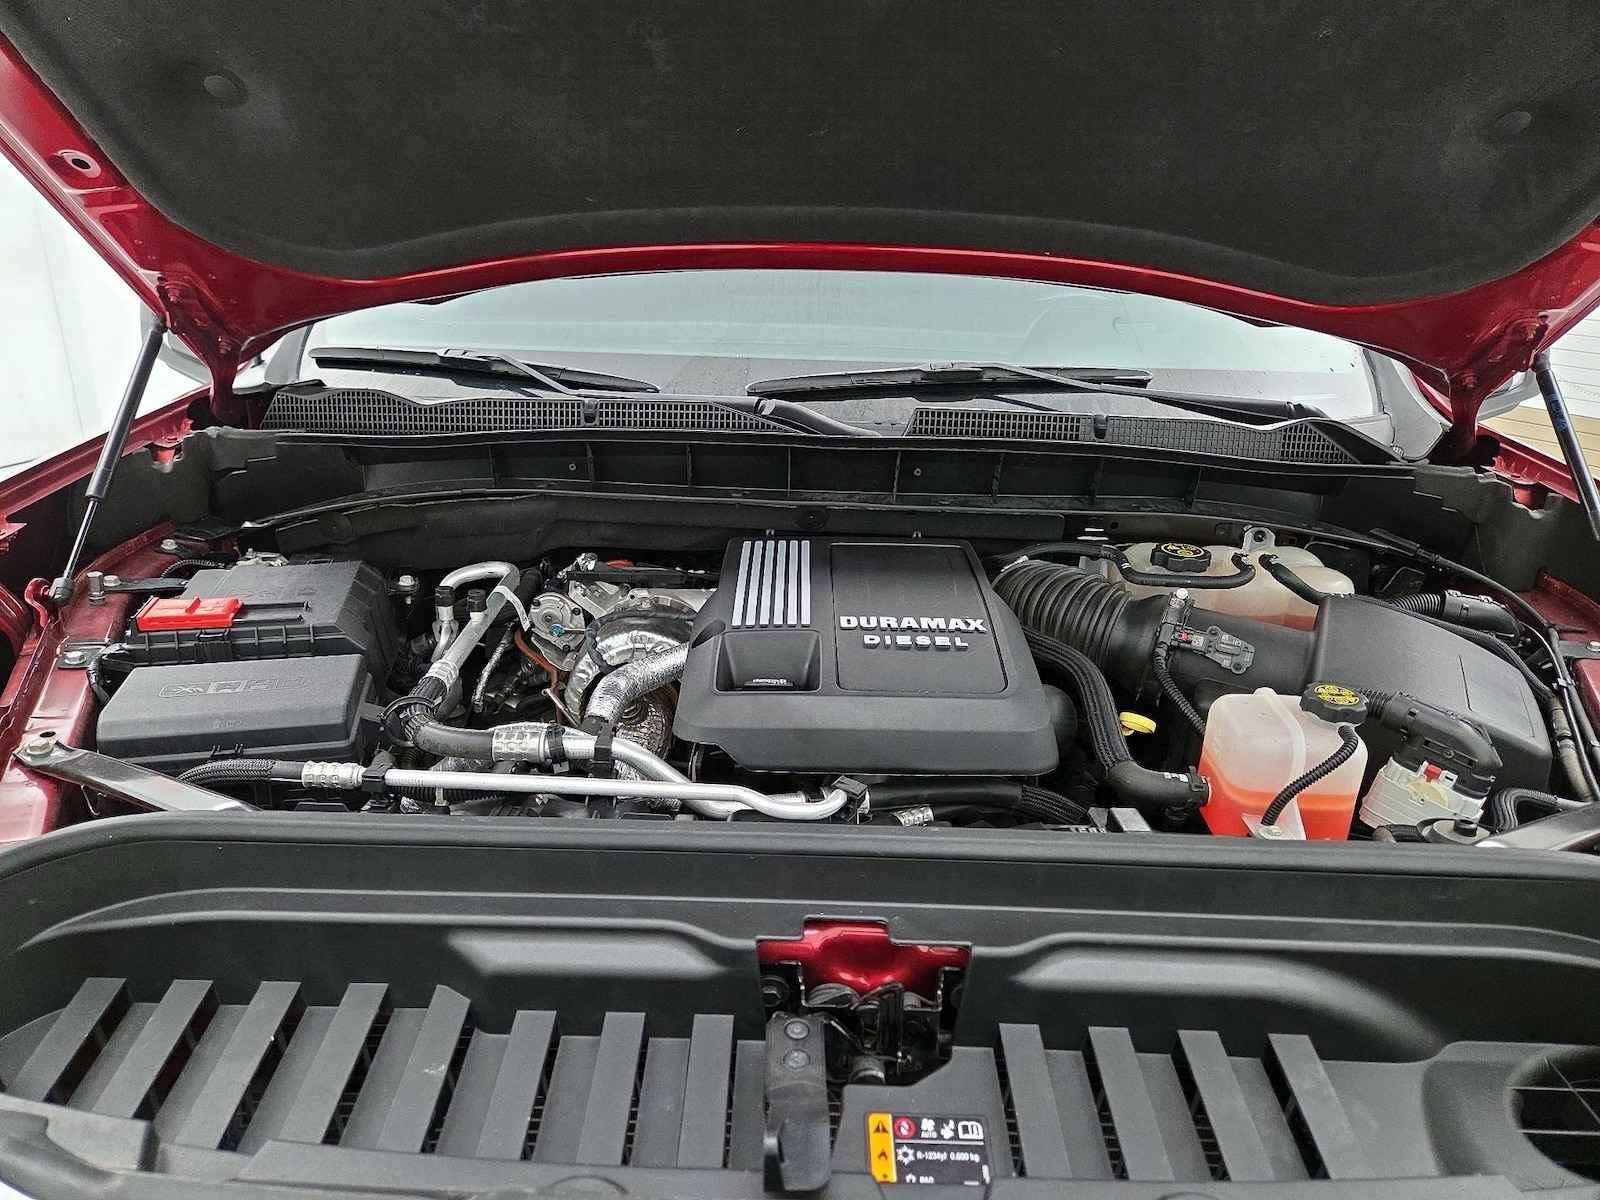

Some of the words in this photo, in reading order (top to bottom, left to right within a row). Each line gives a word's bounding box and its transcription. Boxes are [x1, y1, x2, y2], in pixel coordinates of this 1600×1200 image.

[839, 616, 987, 634] DURAMAX
[863, 635, 969, 649] DIESEL
[921, 1130, 938, 1138] AUTO
[970, 1153, 980, 1163] kg
